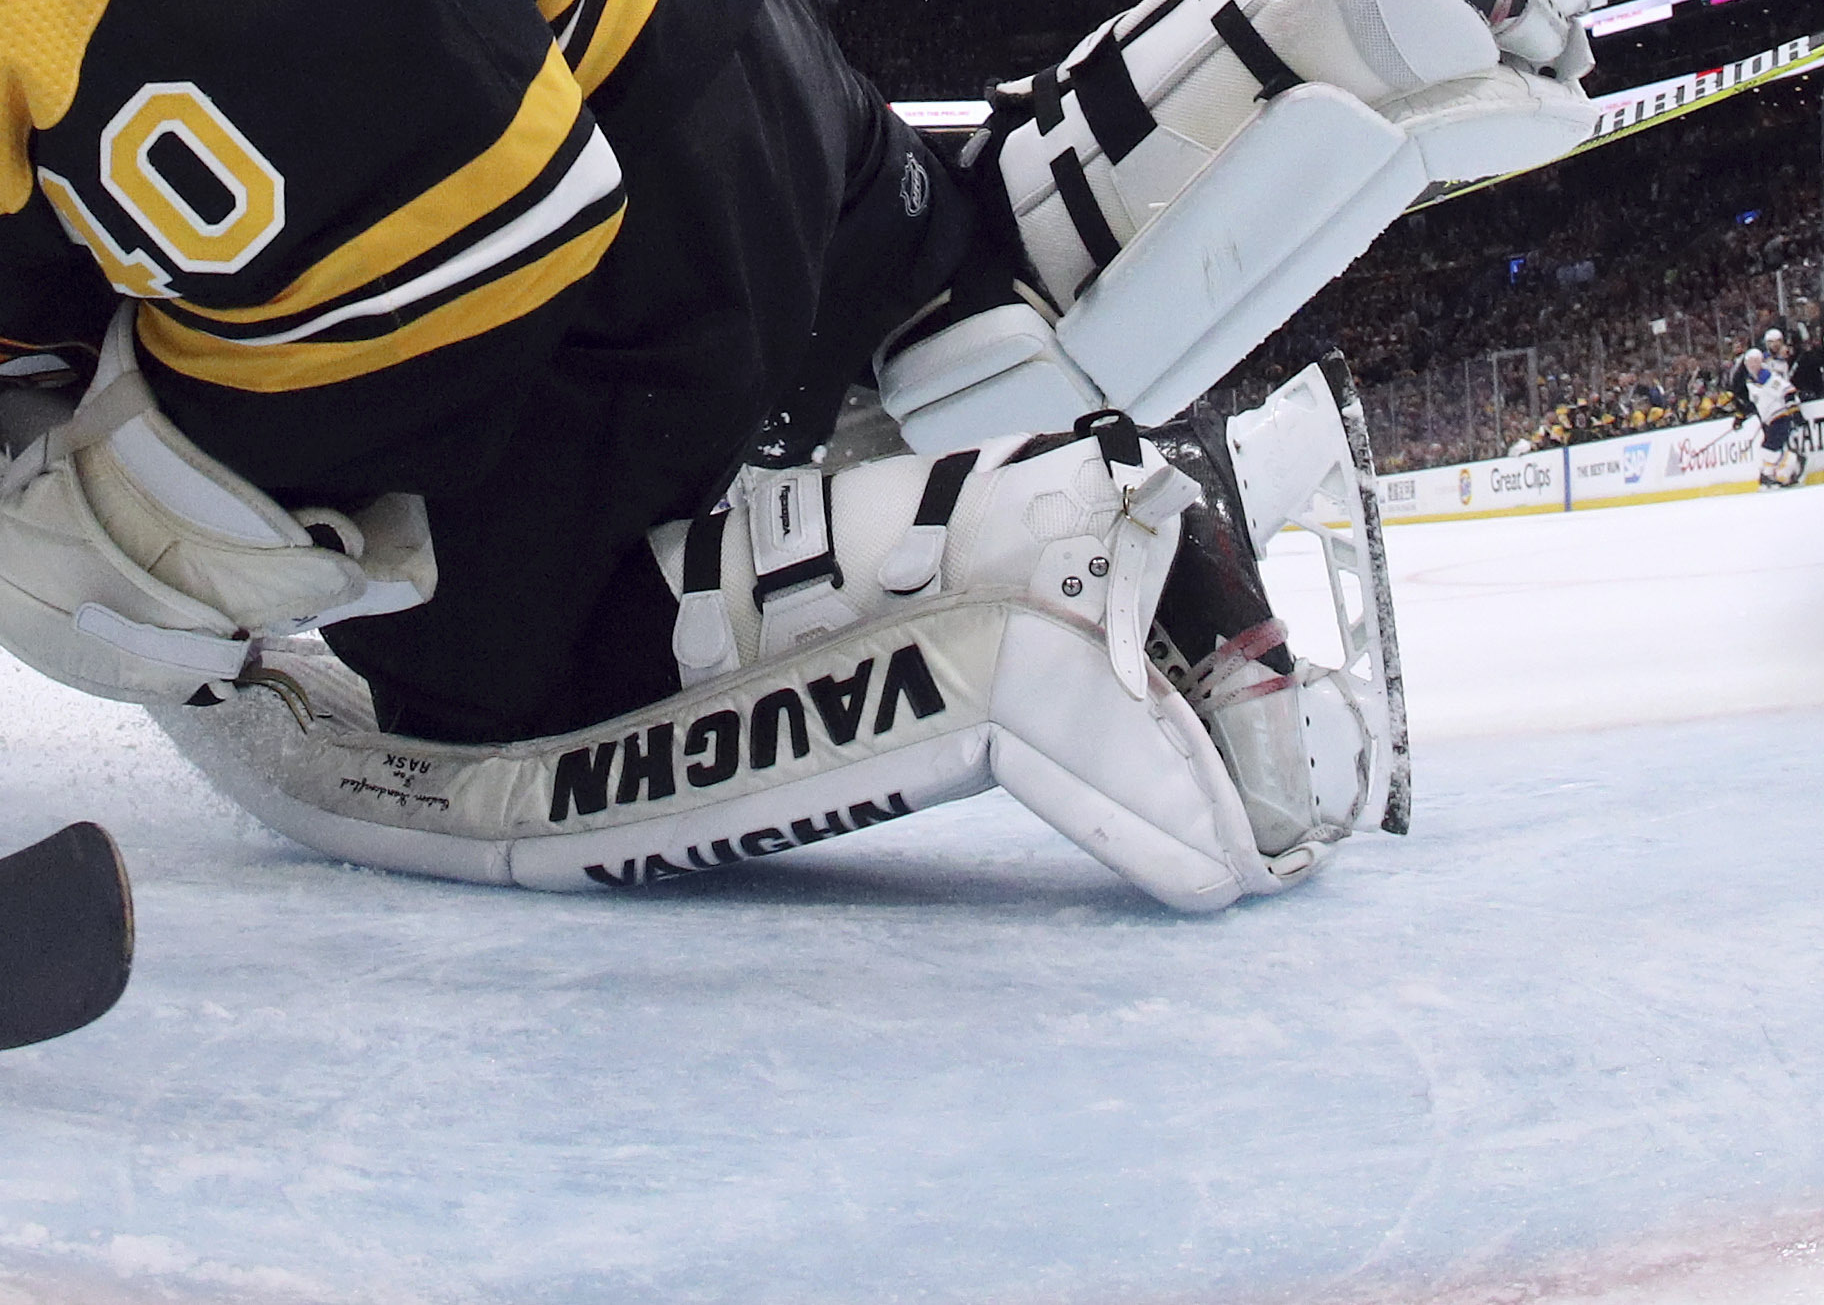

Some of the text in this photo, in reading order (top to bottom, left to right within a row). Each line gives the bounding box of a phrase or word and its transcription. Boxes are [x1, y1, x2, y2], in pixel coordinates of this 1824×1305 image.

[1597, 35, 1813, 137] ARRIOR
[37, 76, 287, 300] 40
[1490, 467, 1522, 494] Great
[1525, 462, 1552, 497] Clips
[1577, 464, 1589, 477] THE
[1590, 462, 1607, 476] BEST
[1678, 438, 1754, 472] Coors LIGHT
[382, 753, 432, 774] RASK
[549, 643, 946, 822] VAUGHN
[584, 791, 914, 888] VAUGHN
